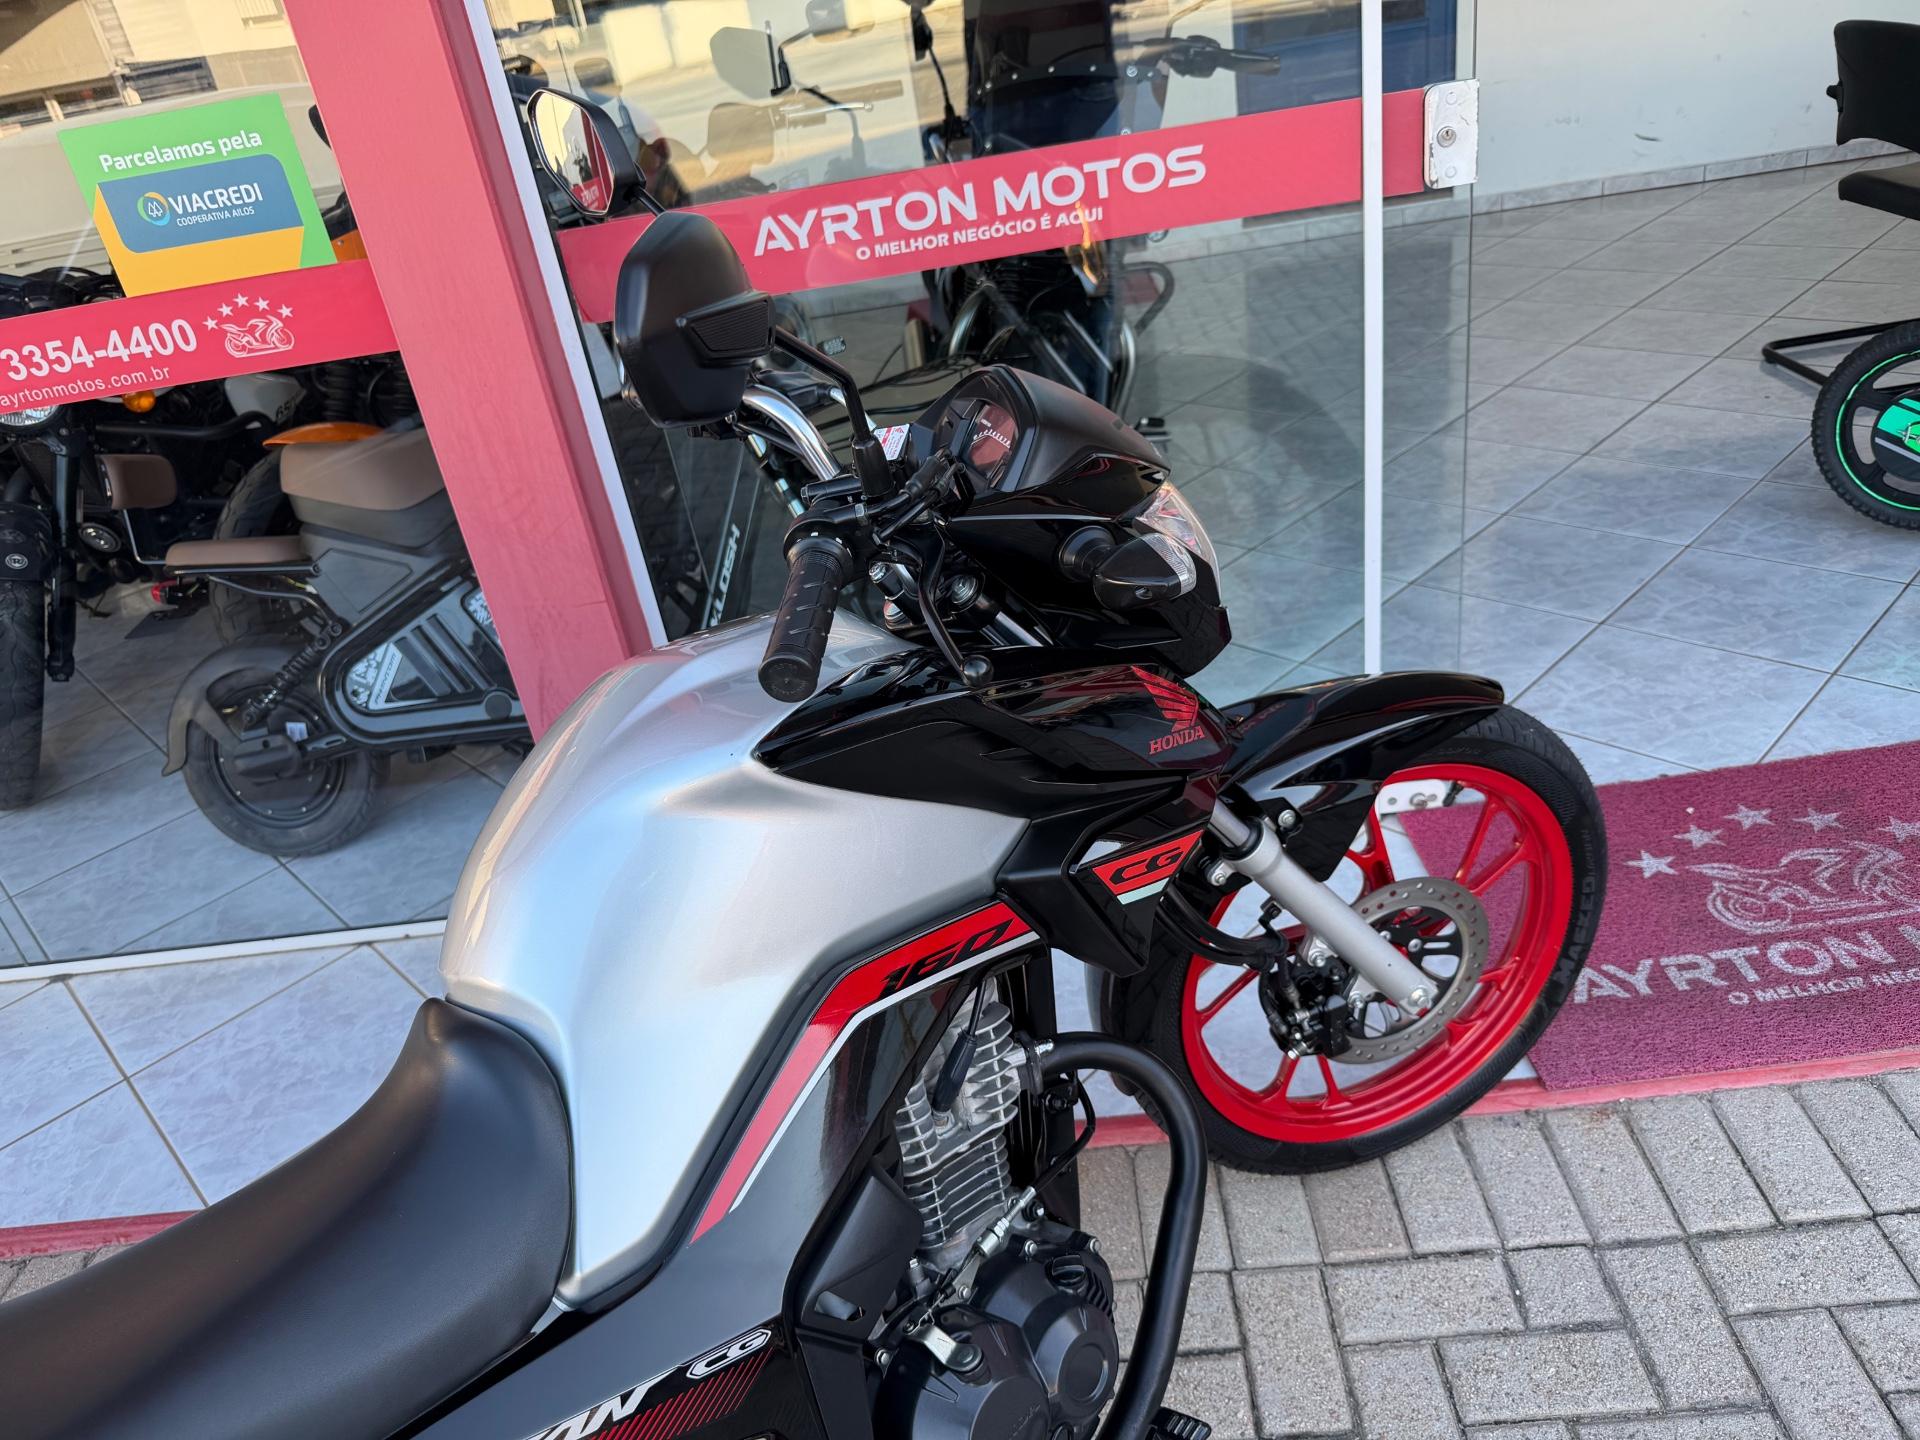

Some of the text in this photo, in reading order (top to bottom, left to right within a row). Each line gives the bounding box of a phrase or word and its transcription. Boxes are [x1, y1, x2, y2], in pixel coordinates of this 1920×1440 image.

[98, 130, 263, 173] Parcelamos pela
[168, 182, 264, 215] VIACREDI
[176, 206, 255, 227] COOPERATIVA AILOS
[754, 144, 1207, 257] AYRTON MOTOS
[856, 207, 1104, 260] O MELHOR NEGÓCIO É AQUI
[0, 319, 198, 381] 3354-4400
[0, 366, 170, 408] ayrtonmotos.com.br
[1149, 725, 1206, 755] HONDA
[1108, 846, 1184, 886] CG
[877, 918, 1014, 1000] 160
[1574, 931, 1896, 1004] AYRTON
[1728, 991, 1750, 1005] O
[1754, 976, 1865, 1002] MELHOR
[687, 1328, 772, 1380] CG
